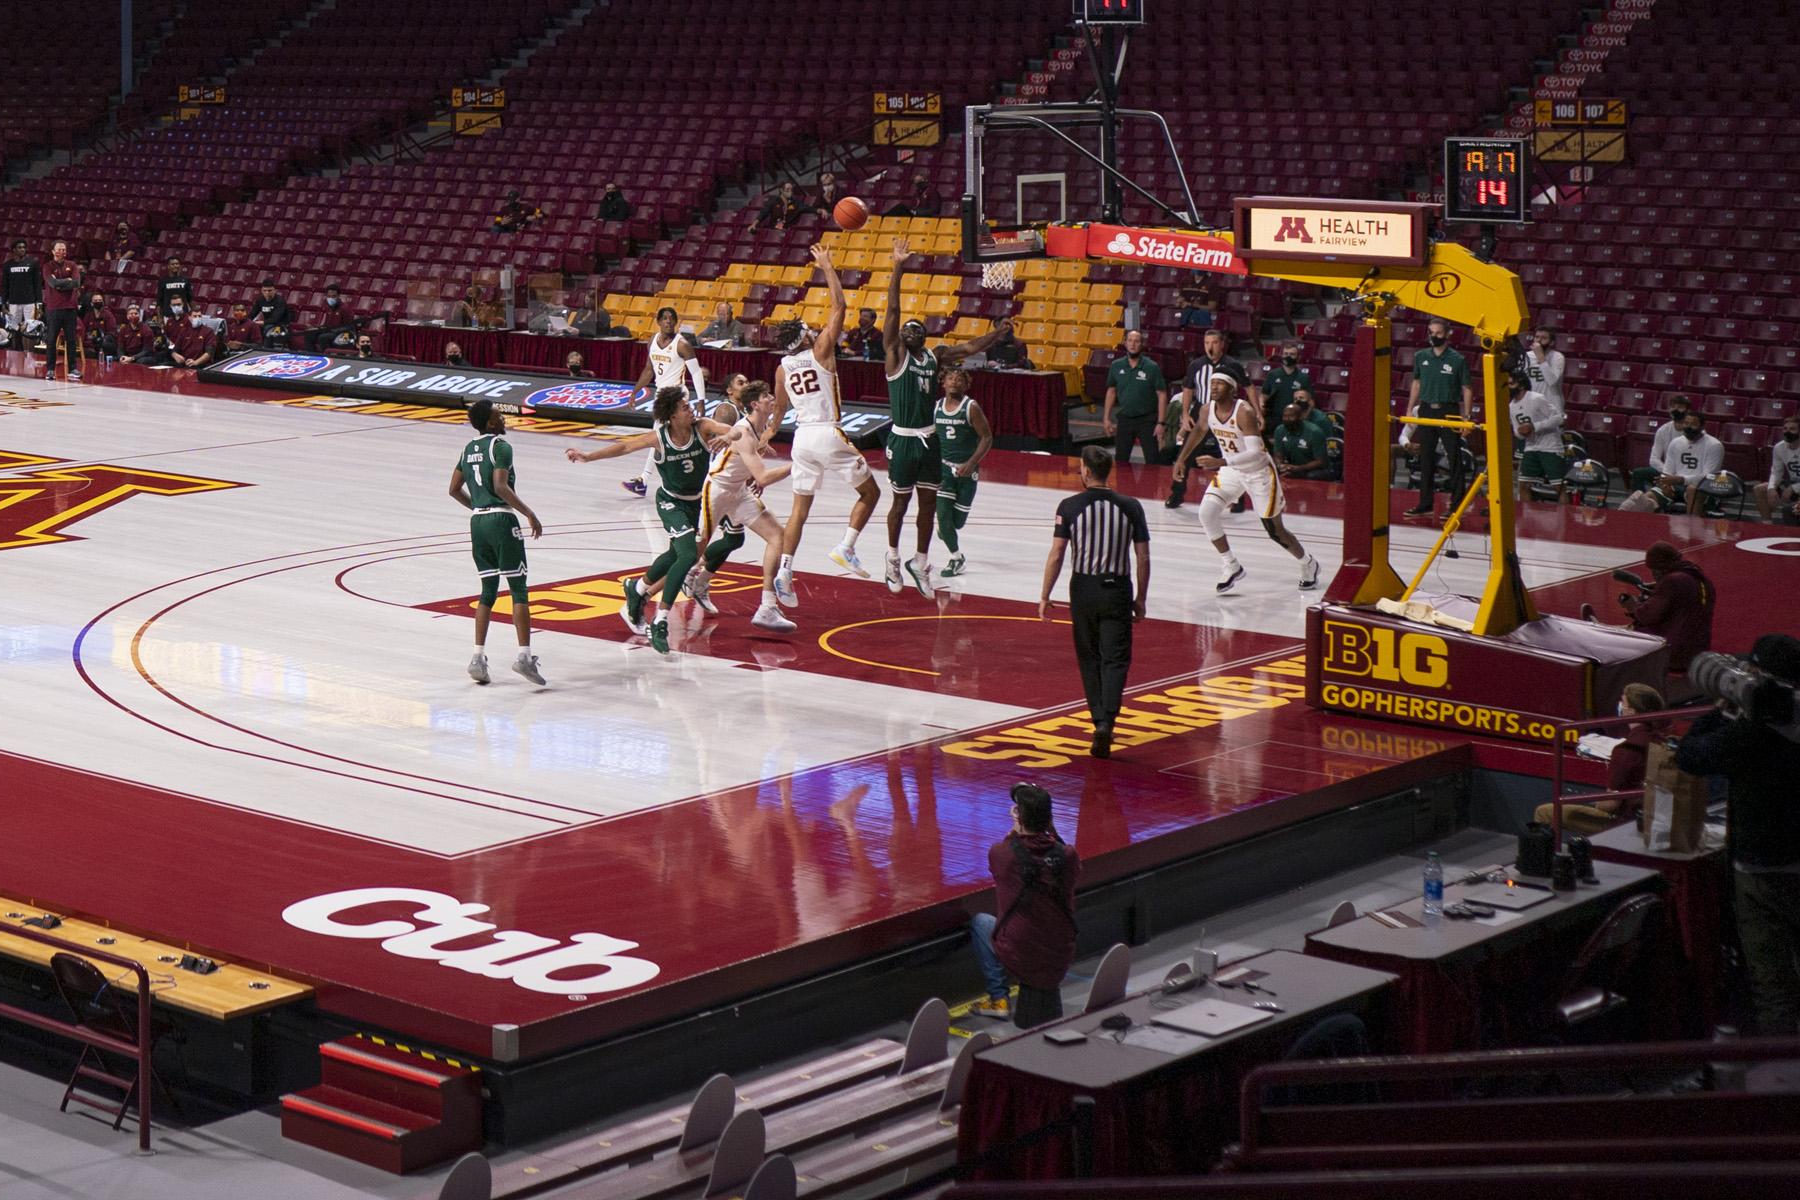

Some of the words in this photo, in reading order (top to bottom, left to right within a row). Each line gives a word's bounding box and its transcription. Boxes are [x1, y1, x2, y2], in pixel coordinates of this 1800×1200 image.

[1554, 104, 1575, 118] 106
[1585, 105, 1604, 118] 107
[1477, 180, 1508, 205] 14
[1320, 218, 1388, 236] HEALTH
[1320, 238, 1368, 246] FAIRVIEW
[313, 365, 351, 381] A
[347, 367, 416, 388] SUB
[408, 375, 522, 397] ABOVE
[790, 369, 820, 395] 22
[946, 426, 956, 440] 2
[683, 460, 694, 473] 3
[1681, 453, 1698, 470] GB
[471, 464, 483, 487] 1
[1322, 685, 1579, 742] GOPHERSPORTS.com
[282, 887, 660, 994] Cub
